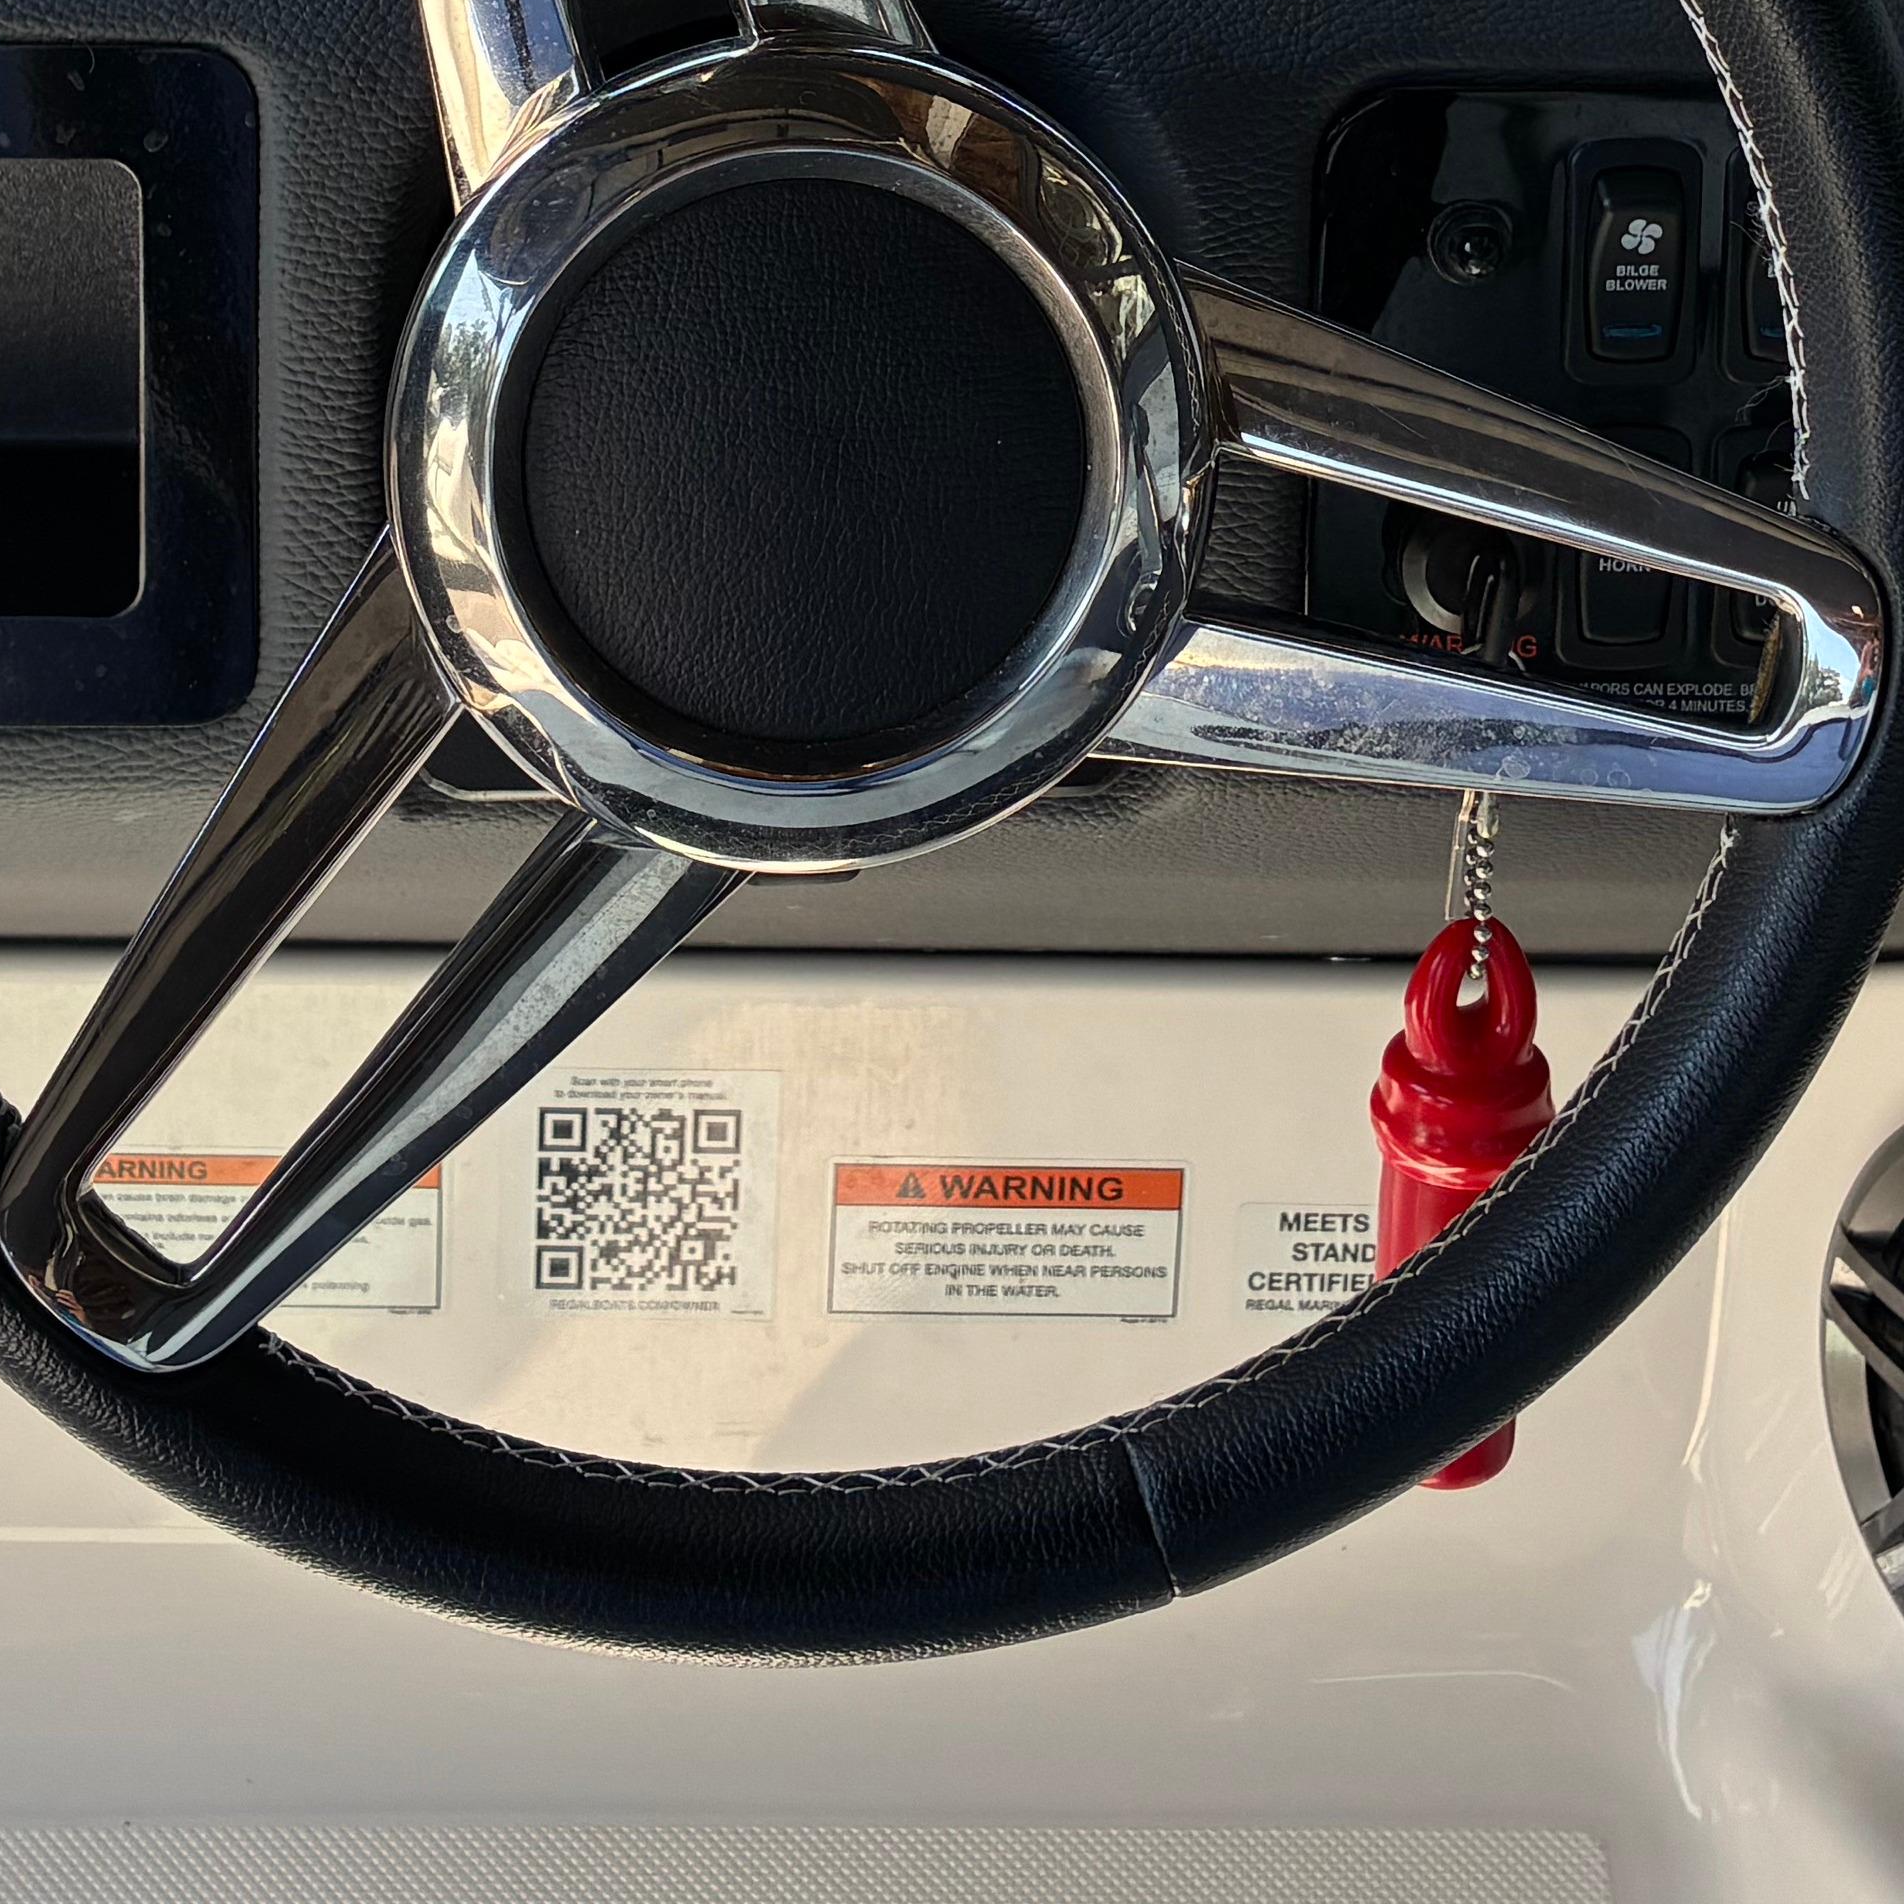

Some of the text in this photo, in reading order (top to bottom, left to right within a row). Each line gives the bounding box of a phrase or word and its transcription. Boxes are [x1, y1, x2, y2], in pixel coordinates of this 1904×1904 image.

[1616, 265, 1660, 277] BILGE
[1606, 279, 1668, 291] BLOWER
[1633, 682, 1664, 696] CAN
[1668, 700, 1678, 711] 4
[940, 1175, 1124, 1201] WARNING
[869, 1221, 1145, 1237] ROTATING PROPELLER MAY CAUSE
[1279, 1212, 1370, 1233] MEETS
[895, 1242, 1116, 1258] SERIOUS INJURY OR DEATH.
[841, 1262, 1168, 1278] SHUT OFF ENGINE WHEN NEAR PERSONS
[945, 1284, 1060, 1298] IN THE WATER.
[1246, 1299, 1294, 1311] REGAL
